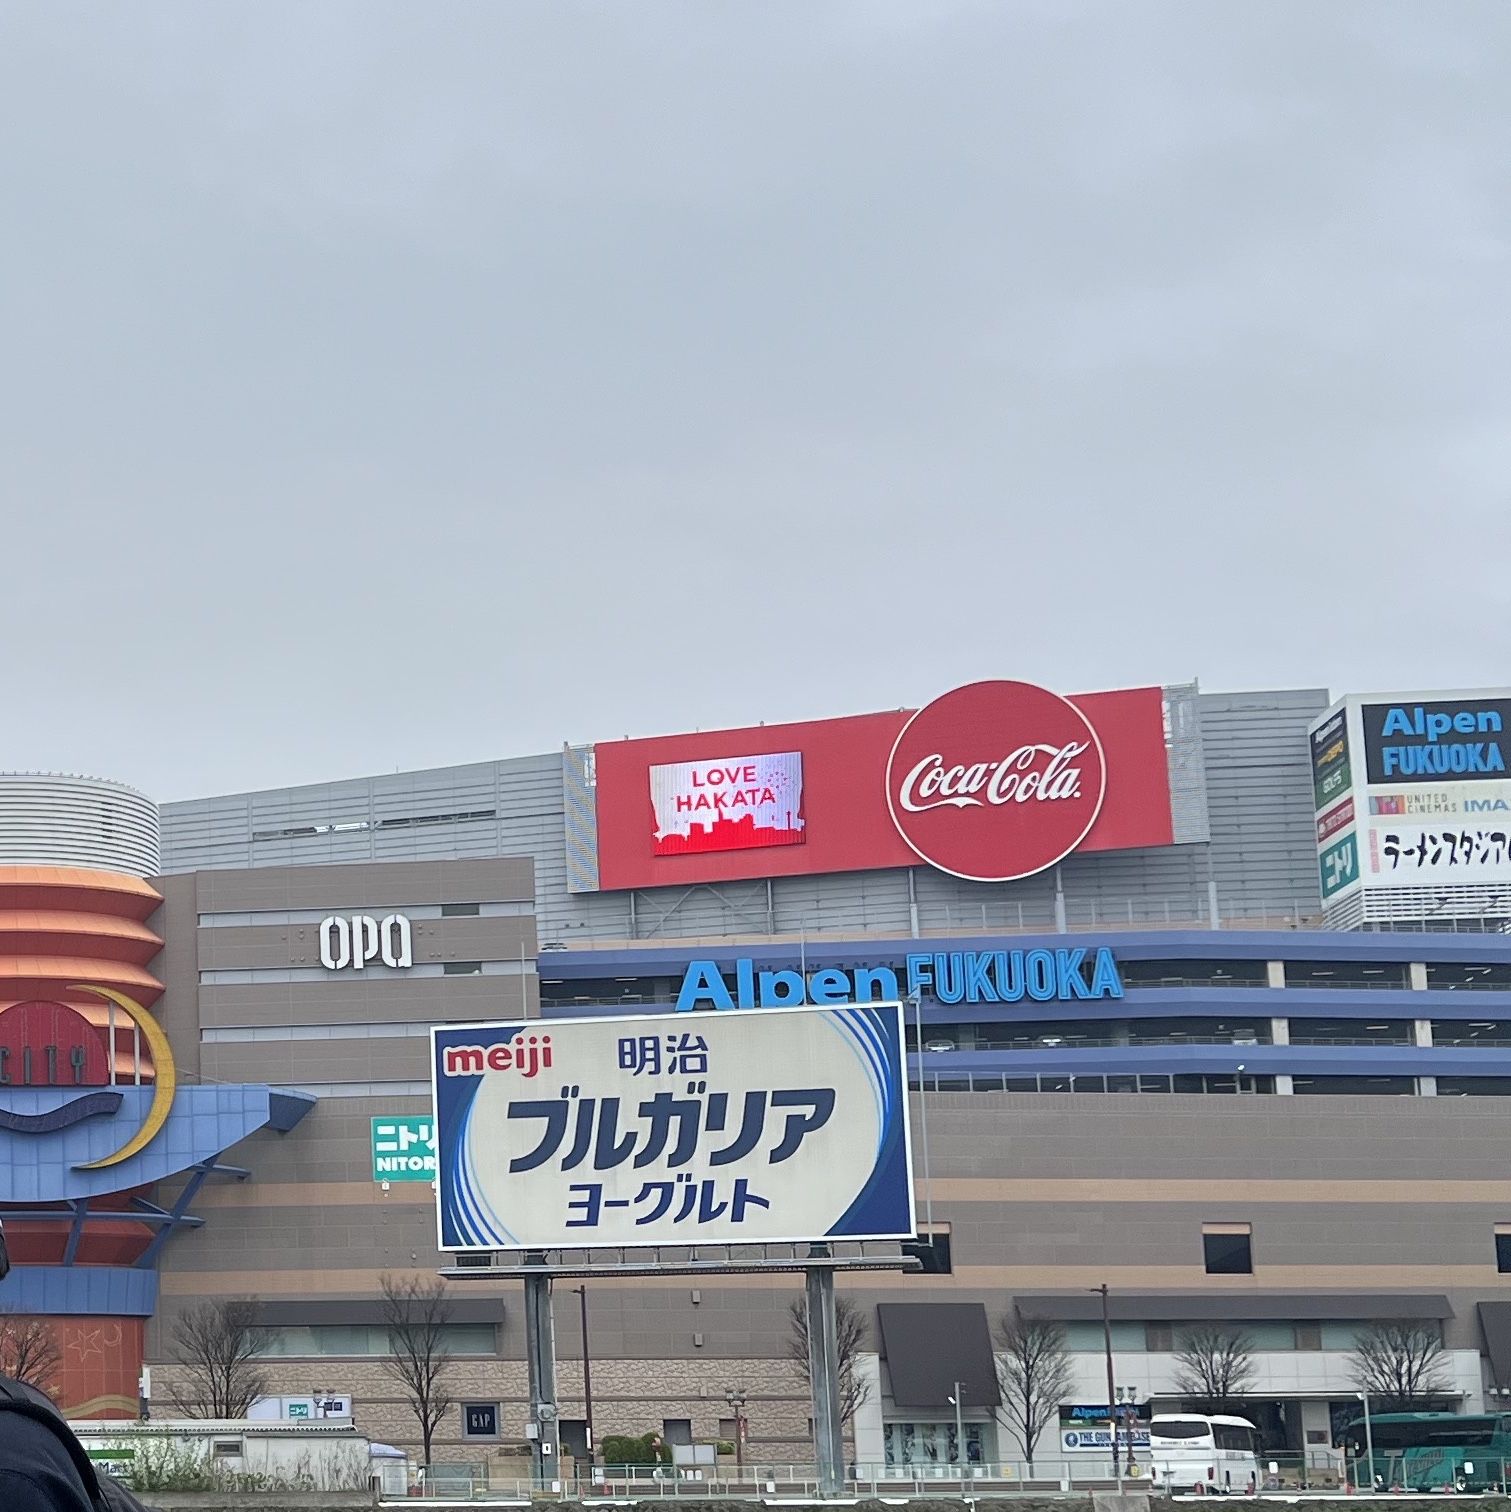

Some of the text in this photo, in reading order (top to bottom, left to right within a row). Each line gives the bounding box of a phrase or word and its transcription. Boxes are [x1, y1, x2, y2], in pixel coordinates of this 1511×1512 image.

[1382, 706, 1502, 742] Alpen
[899, 740, 1092, 812] Coca-Cola
[1382, 742, 1506, 776] FUKUOKA
[691, 765, 757, 789] LOVE
[676, 787, 777, 813] HAKATA
[1406, 793, 1448, 804] UNITED
[1407, 803, 1457, 814] CINEMAS
[1464, 799, 1511, 812] IMA
[1384, 830, 1511, 869] ラーメンスタジア
[674, 944, 1126, 1013] Alpen FUKUOKA
[446, 1034, 553, 1078] meiji
[617, 1032, 710, 1077] 明治
[506, 1080, 837, 1175] ブルガリア
[376, 1156, 437, 1172] NITOR
[564, 1173, 771, 1229] ヨーグルト
[471, 1413, 491, 1428] GAP
[1078, 1431, 1094, 1443] THE
